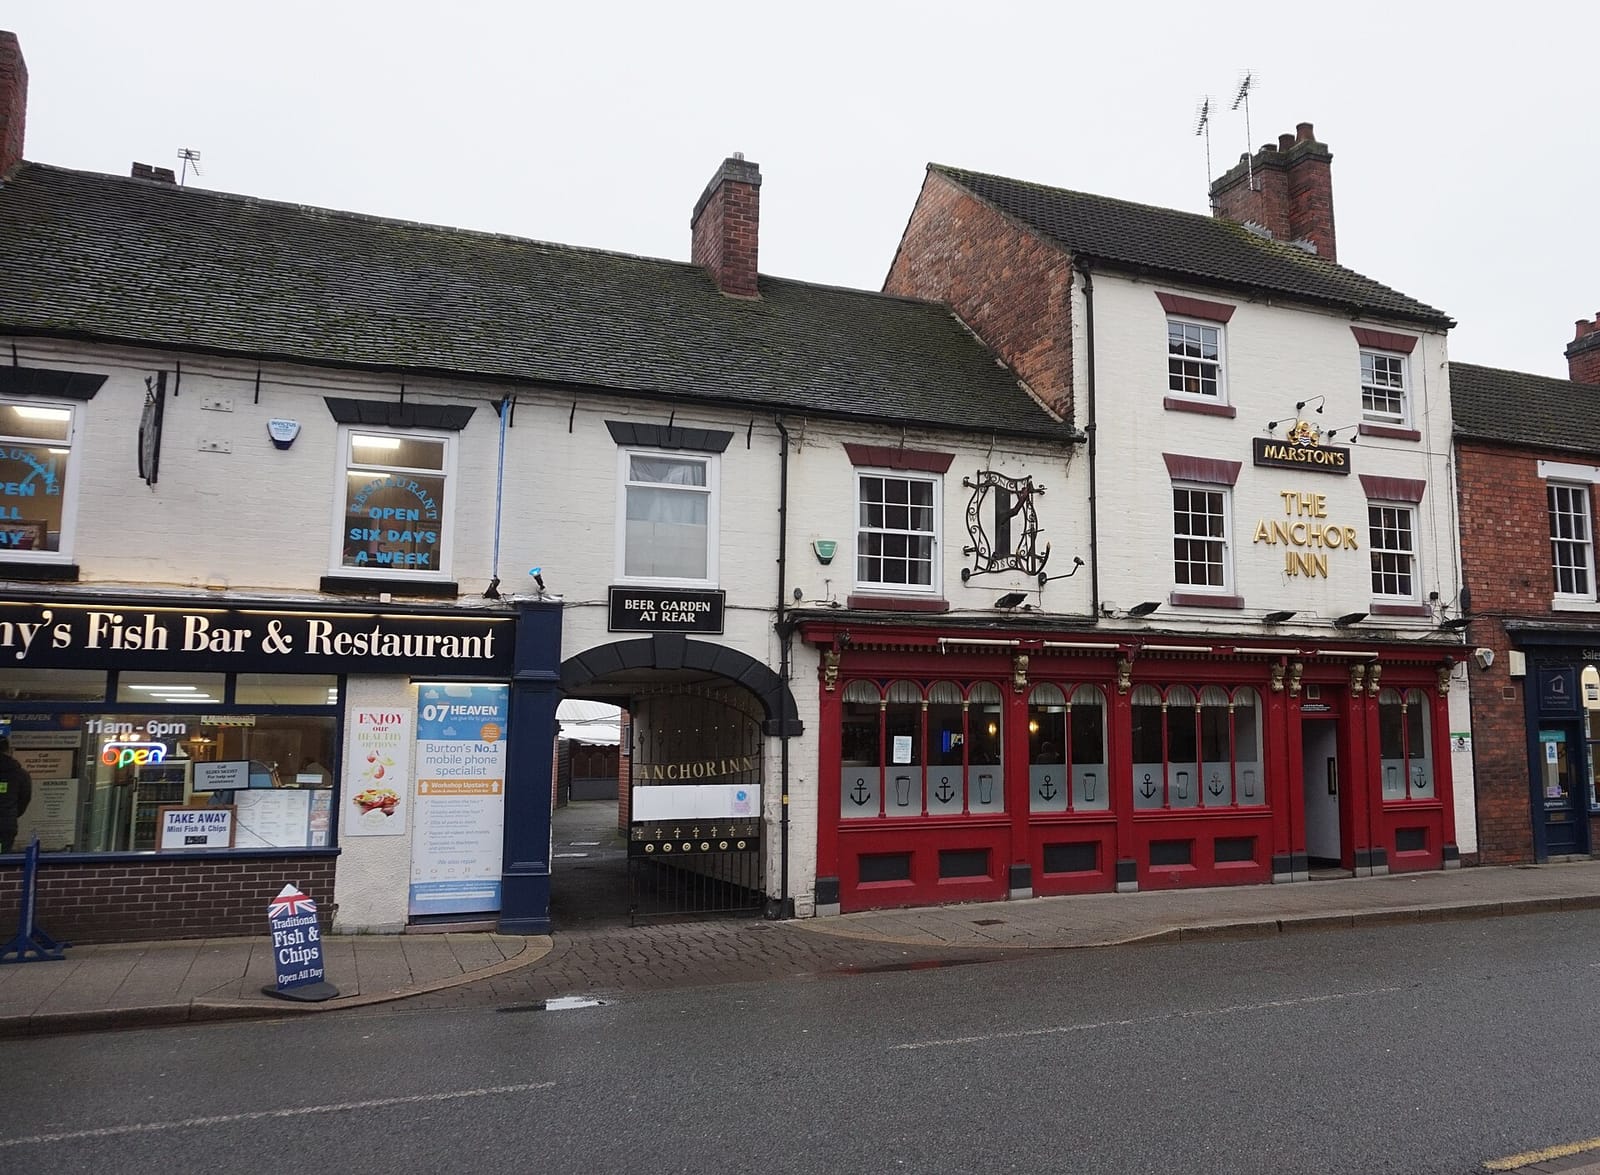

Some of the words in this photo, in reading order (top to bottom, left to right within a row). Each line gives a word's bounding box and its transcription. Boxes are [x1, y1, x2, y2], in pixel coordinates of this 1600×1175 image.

[1263, 444, 1345, 466] MARSTON'S
[350, 476, 438, 519] RESTAURANT
[1280, 489, 1328, 518] THE
[368, 507, 419, 521] OPEN
[349, 528, 381, 541] SIX
[387, 529, 437, 544] DAYS
[1253, 519, 1358, 550] ANCHOR
[354, 550, 369, 563] A
[375, 551, 430, 565] WEEK
[1285, 551, 1328, 579] INN
[624, 599, 655, 610] BEER
[660, 600, 711, 612] GARDEN
[639, 611, 658, 622] AT
[661, 611, 696, 623] REAR
[84, 612, 169, 650] Fish
[180, 615, 252, 654] Bar
[261, 619, 293, 655] &
[304, 619, 496, 659] Restaurant
[359, 713, 404, 724] ENJOY
[423, 704, 450, 723] 07
[450, 705, 498, 716] HEAVEN
[85, 719, 133, 734] 11am
[146, 720, 187, 738] 6pm
[425, 743, 472, 753] Burton's
[474, 743, 499, 753] No.1
[102, 747, 166, 769] open
[425, 754, 462, 764] mobile
[464, 755, 498, 766] phone
[435, 766, 487, 776] specialist
[639, 761, 717, 780] ANCHOR
[721, 755, 754, 775] INN
[169, 813, 195, 824] TAKE
[197, 812, 227, 823] AWAY
[166, 825, 182, 833] Mini
[207, 825, 227, 833] Chips
[272, 914, 317, 930] Traditional
[273, 928, 305, 948] Fish
[308, 926, 320, 942] &
[279, 946, 319, 966] Chips
[278, 974, 298, 985] Open
[298, 970, 308, 979] All
[309, 968, 323, 978] Day
